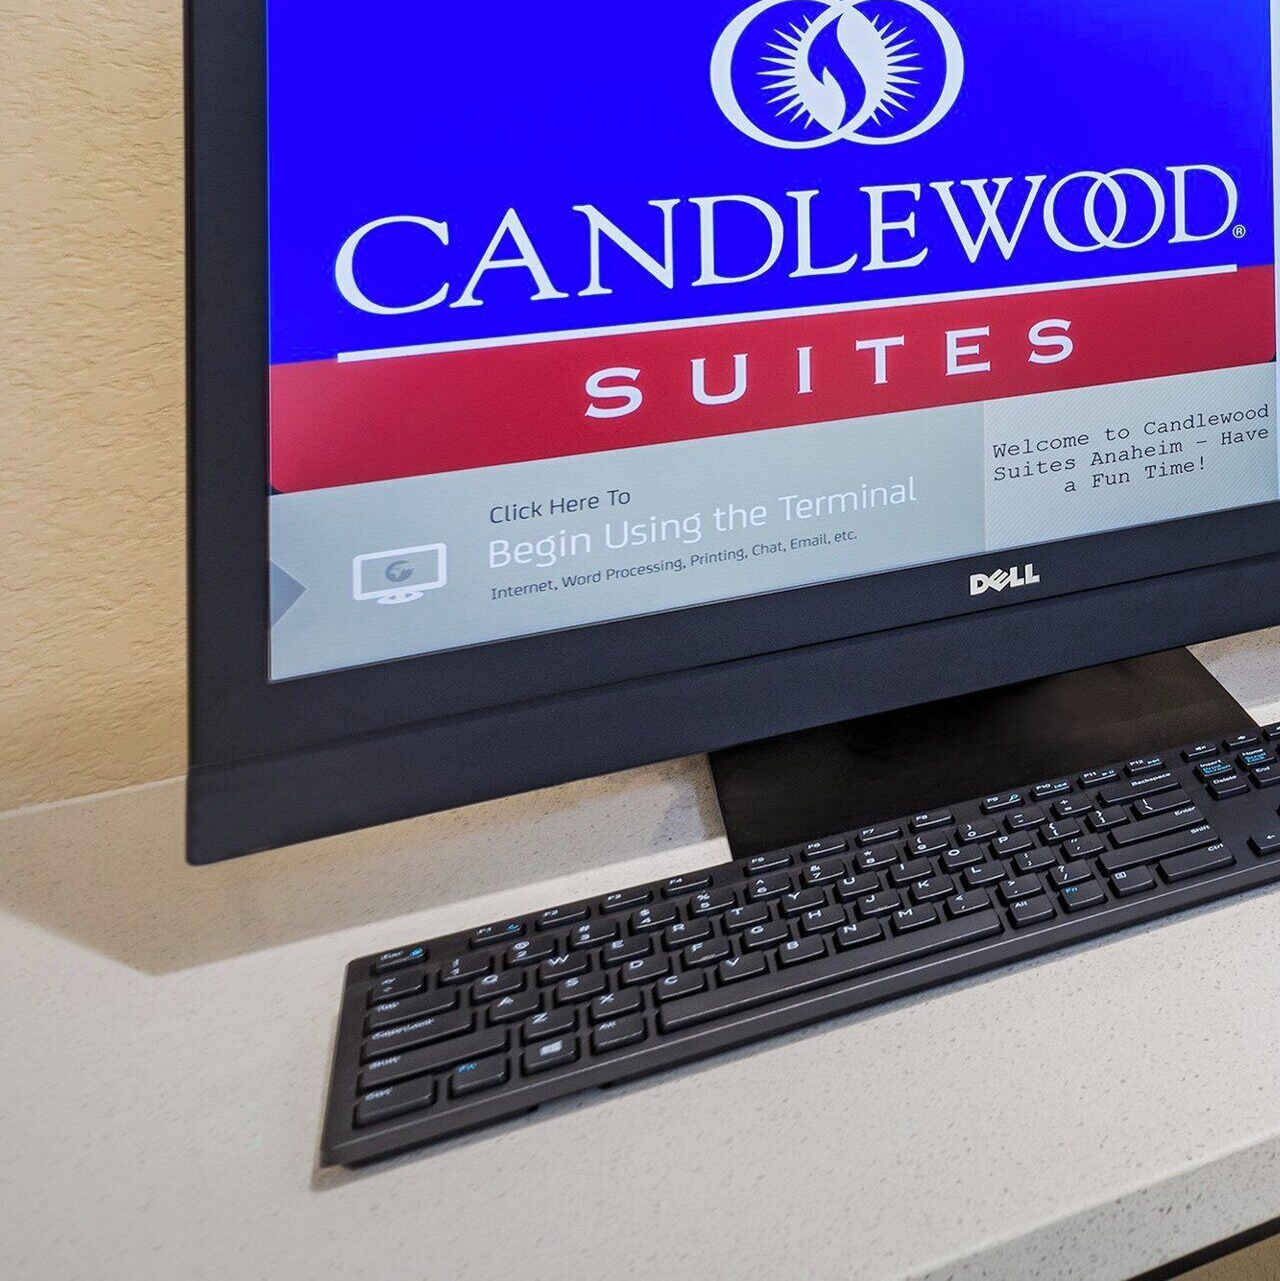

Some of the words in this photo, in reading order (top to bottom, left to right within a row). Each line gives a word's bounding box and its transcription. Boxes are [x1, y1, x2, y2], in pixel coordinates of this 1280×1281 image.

[584, 318, 1074, 419] SUITES
[992, 433, 1090, 459] Welcome
[1105, 427, 1130, 442] to
[1144, 404, 1269, 436] Candlewood
[993, 458, 1077, 482] Suites
[1091, 441, 1183, 467] Anaheim
[1221, 427, 1270, 446] Have
[1064, 479, 1077, 493] a
[1092, 471, 1131, 489] Fun
[1145, 456, 1206, 480] Time!
[489, 501, 543, 524] Click
[550, 493, 600, 514] Here
[606, 488, 631, 506] To
[489, 528, 591, 568] Begin
[605, 512, 702, 550] Using
[713, 503, 767, 532] the
[779, 476, 917, 523] Terminal
[491, 578, 558, 600] Internet,
[562, 571, 601, 588] Word
[606, 557, 687, 582] Processing,
[690, 545, 748, 567] Printing,
[752, 540, 786, 557] Chat,
[790, 532, 831, 551] Email,
[834, 530, 857, 542] etc.
[970, 563, 1040, 596] DELL
[1242, 748, 1264, 756] Home
[1200, 759, 1221, 768] Insert
[1255, 765, 1271, 773] End
[1131, 772, 1171, 787] Backspace
[1213, 774, 1237, 785] Delete
[1174, 806, 1195, 816] Enter
[1190, 824, 1210, 834] Shift
[998, 836, 1008, 844] P
[1207, 843, 1224, 852] Ctrl
[971, 866, 981, 874] L
[843, 876, 856, 884] U
[917, 879, 930, 888] K
[788, 891, 800, 900] Y
[865, 894, 875, 903] J
[1015, 900, 1028, 908] Alt
[731, 907, 744, 915] T
[808, 910, 822, 919] H
[898, 908, 914, 918] M
[672, 923, 685, 932] R
[843, 924, 857, 933] N
[611, 939, 624, 949] E
[692, 943, 704, 952] F
[787, 941, 799, 950] B
[549, 954, 570, 966] W
[629, 959, 644, 969] D
[725, 957, 741, 967] V
[564, 976, 579, 988] S
[664, 975, 679, 985] C
[498, 996, 514, 1007] A
[600, 993, 615, 1004] X
[532, 1012, 548, 1024] Z
